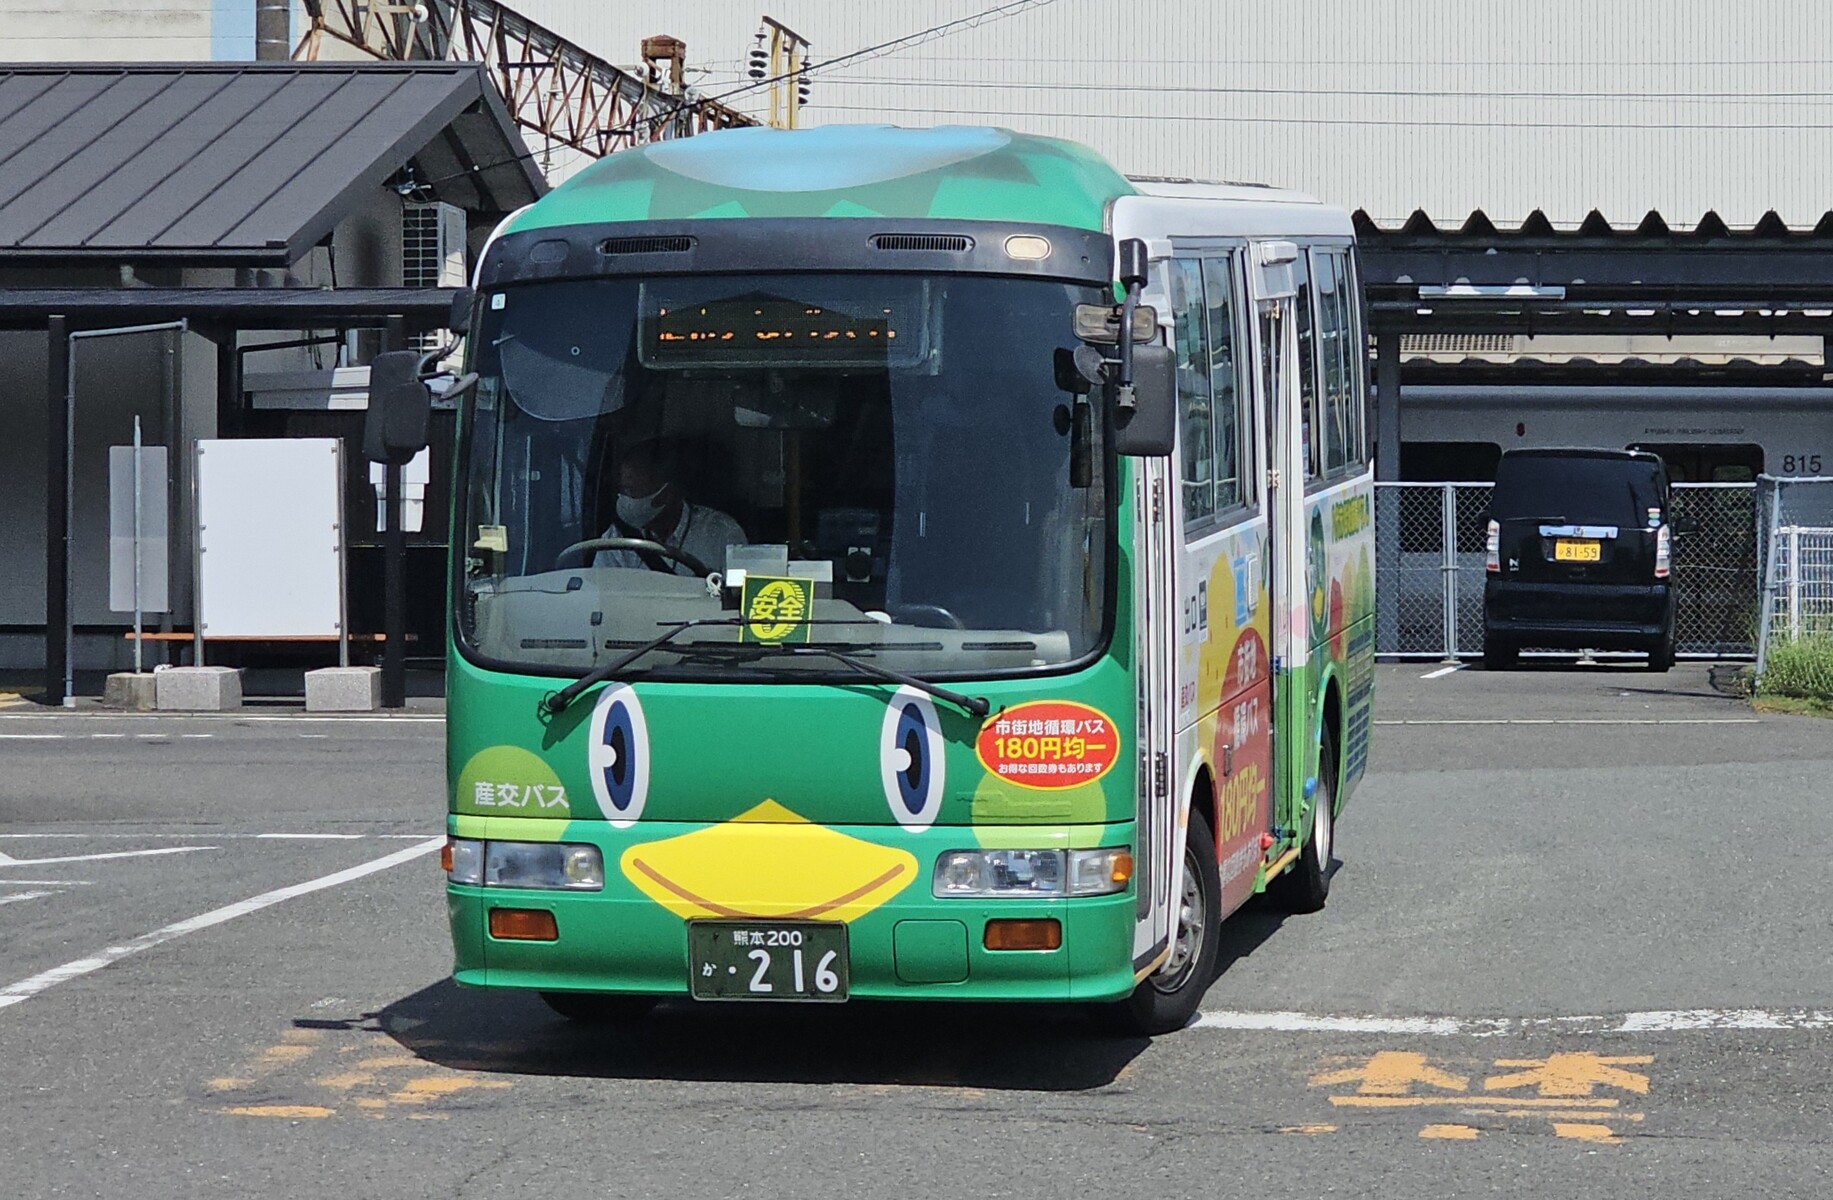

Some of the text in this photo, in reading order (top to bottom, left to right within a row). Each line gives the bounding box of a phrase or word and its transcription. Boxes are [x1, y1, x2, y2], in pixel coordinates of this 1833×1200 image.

[1782, 454, 1822, 474] 815
[1565, 546, 1598, 559] 81-59
[751, 594, 804, 621] 安全
[995, 719, 1105, 735] 市街地循環バス
[994, 736, 1107, 760] 180円均一
[475, 781, 570, 808] 産交バス
[702, 962, 717, 977] か
